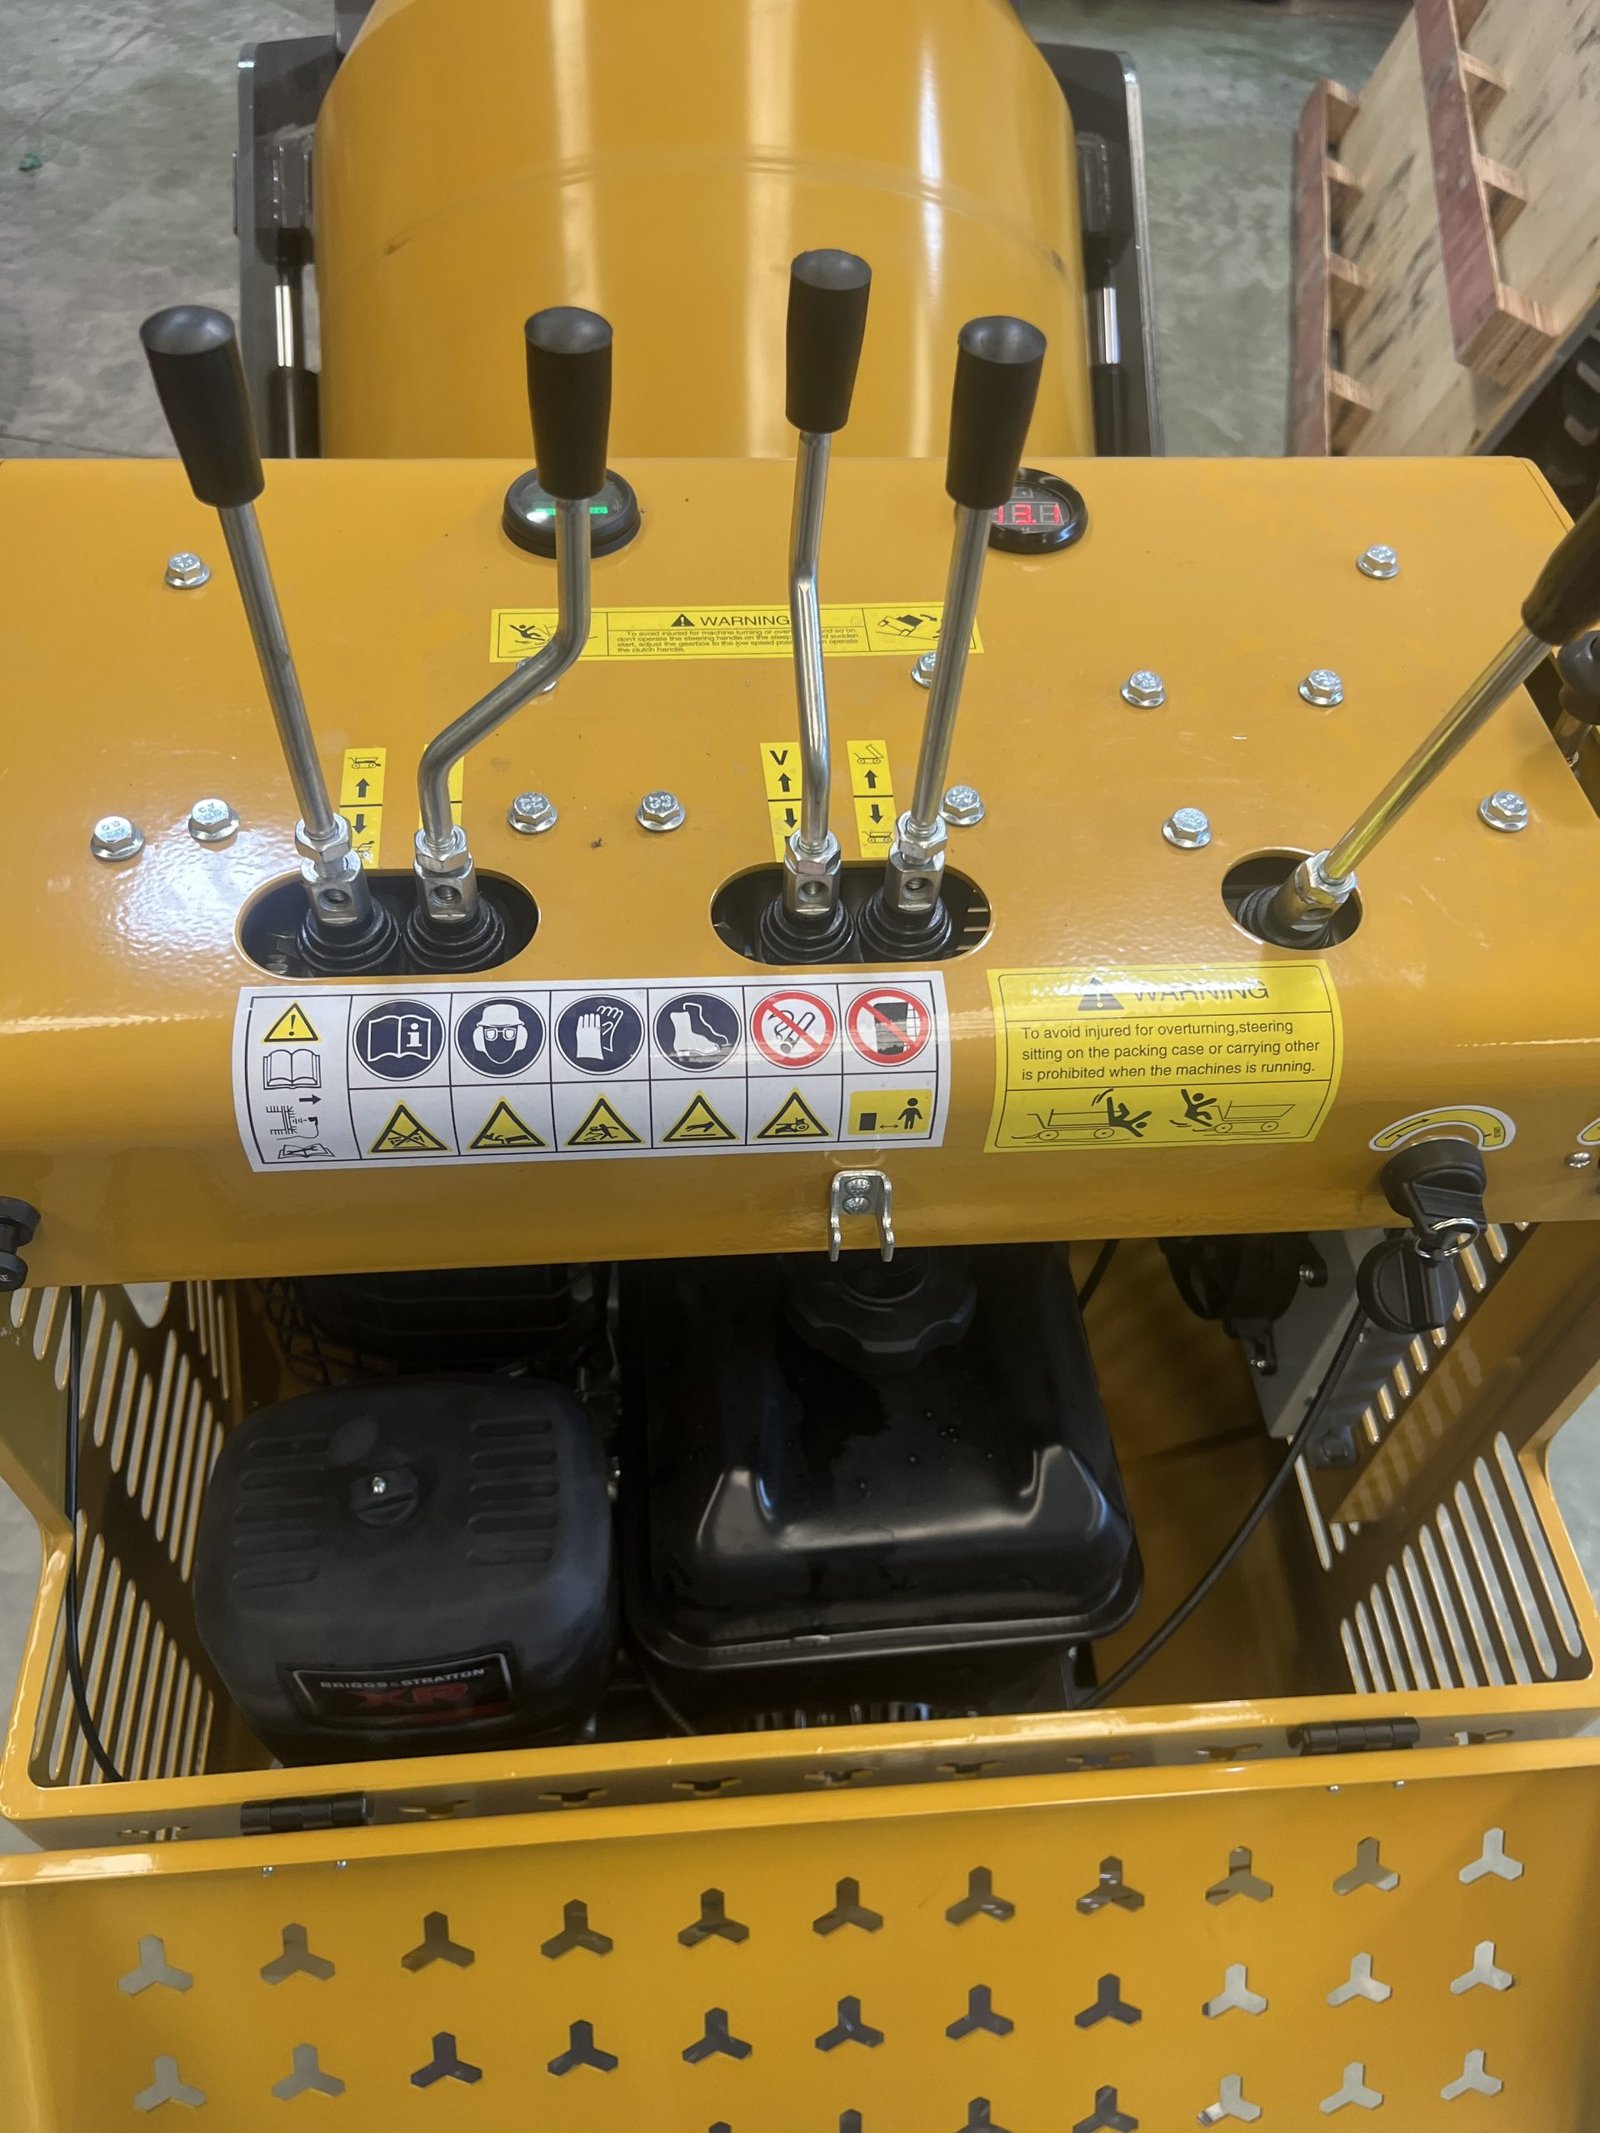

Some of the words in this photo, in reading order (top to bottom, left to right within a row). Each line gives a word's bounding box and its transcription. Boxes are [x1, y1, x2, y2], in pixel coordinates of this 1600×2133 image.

[997, 504, 1060, 525] 13.1
[700, 616, 790, 626] WARNING
[683, 634, 714, 642] steering
[769, 750, 788, 765] V
[1021, 1027, 1040, 1040] To
[1044, 1026, 1081, 1039] avoid
[1085, 1024, 1131, 1040] injured
[1136, 1024, 1154, 1036] for
[1022, 1047, 1062, 1062] sitting
[1067, 1049, 1084, 1060] on
[1089, 1046, 1110, 1058] the
[1114, 1044, 1168, 1060] packing
[1171, 1045, 1204, 1056] case
[1208, 1044, 1223, 1055] or
[1226, 1041, 1281, 1056] carrying
[1285, 1039, 1320, 1053] other
[1022, 1068, 1033, 1080] is
[1037, 1066, 1105, 1082] prohibited
[1109, 1065, 1146, 1077] when
[1151, 1064, 1172, 1076] the
[1176, 1062, 1242, 1075] machines
[1246, 1061, 1257, 1073] is
[1261, 1060, 1315, 1074] running.
